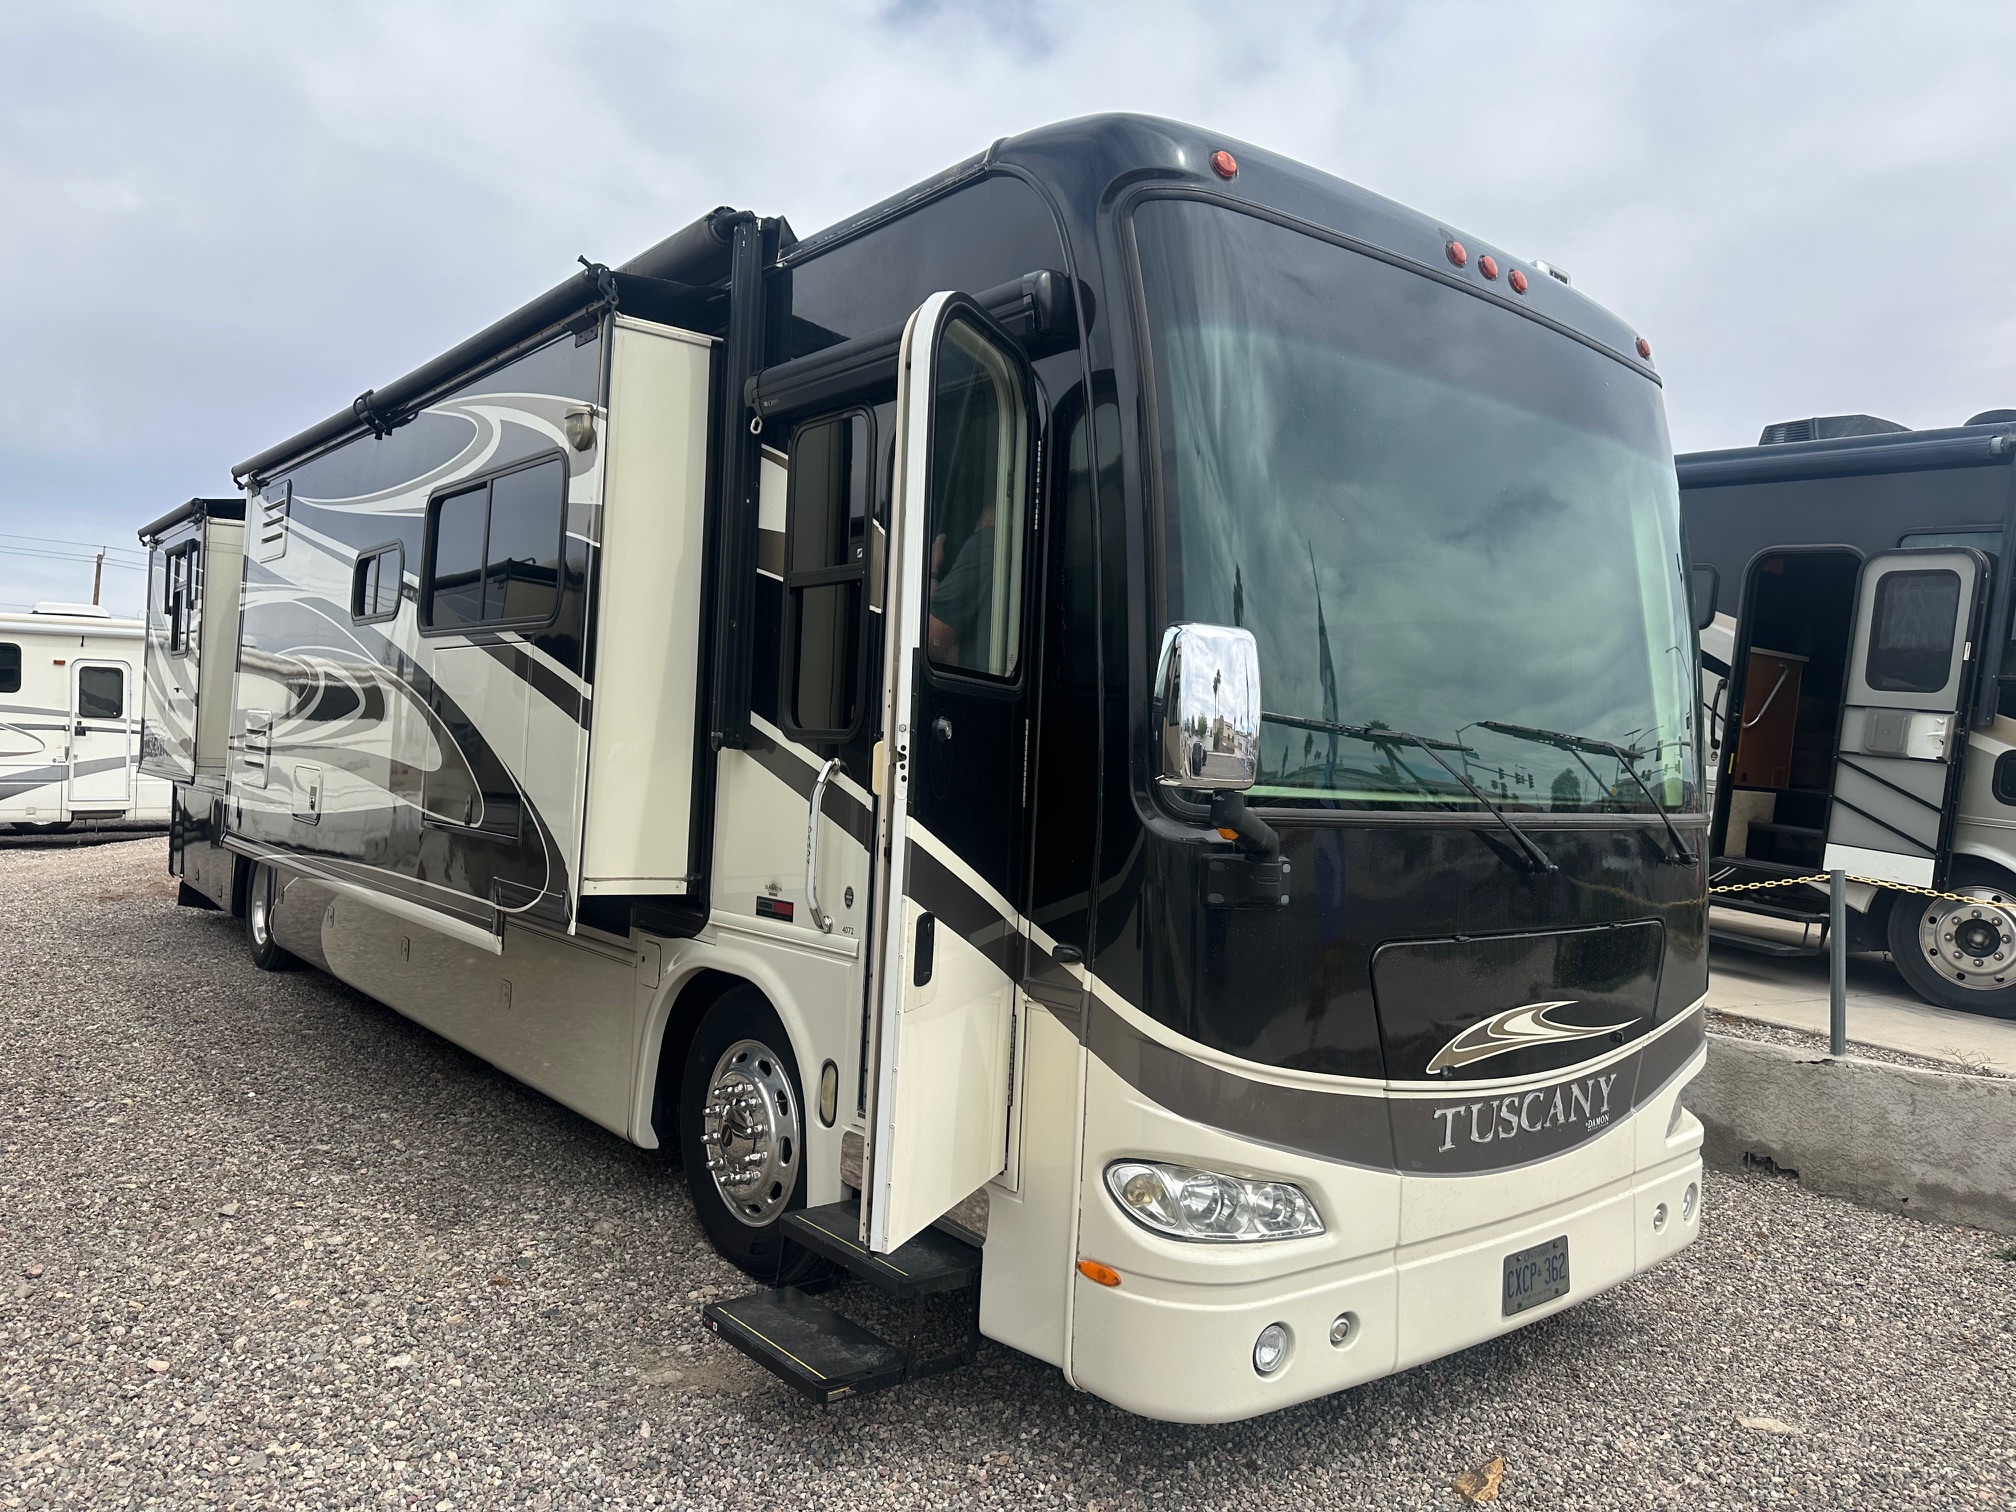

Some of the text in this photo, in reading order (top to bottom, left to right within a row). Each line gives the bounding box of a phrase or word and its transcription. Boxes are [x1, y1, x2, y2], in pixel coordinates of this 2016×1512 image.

[842, 926, 854, 935] 4072
[1433, 1073, 1618, 1153] TUSCANY
[1587, 1113, 1610, 1129] DAMON
[1507, 1261, 1537, 1299] CXCP
[1544, 1252, 1566, 1285] 362
